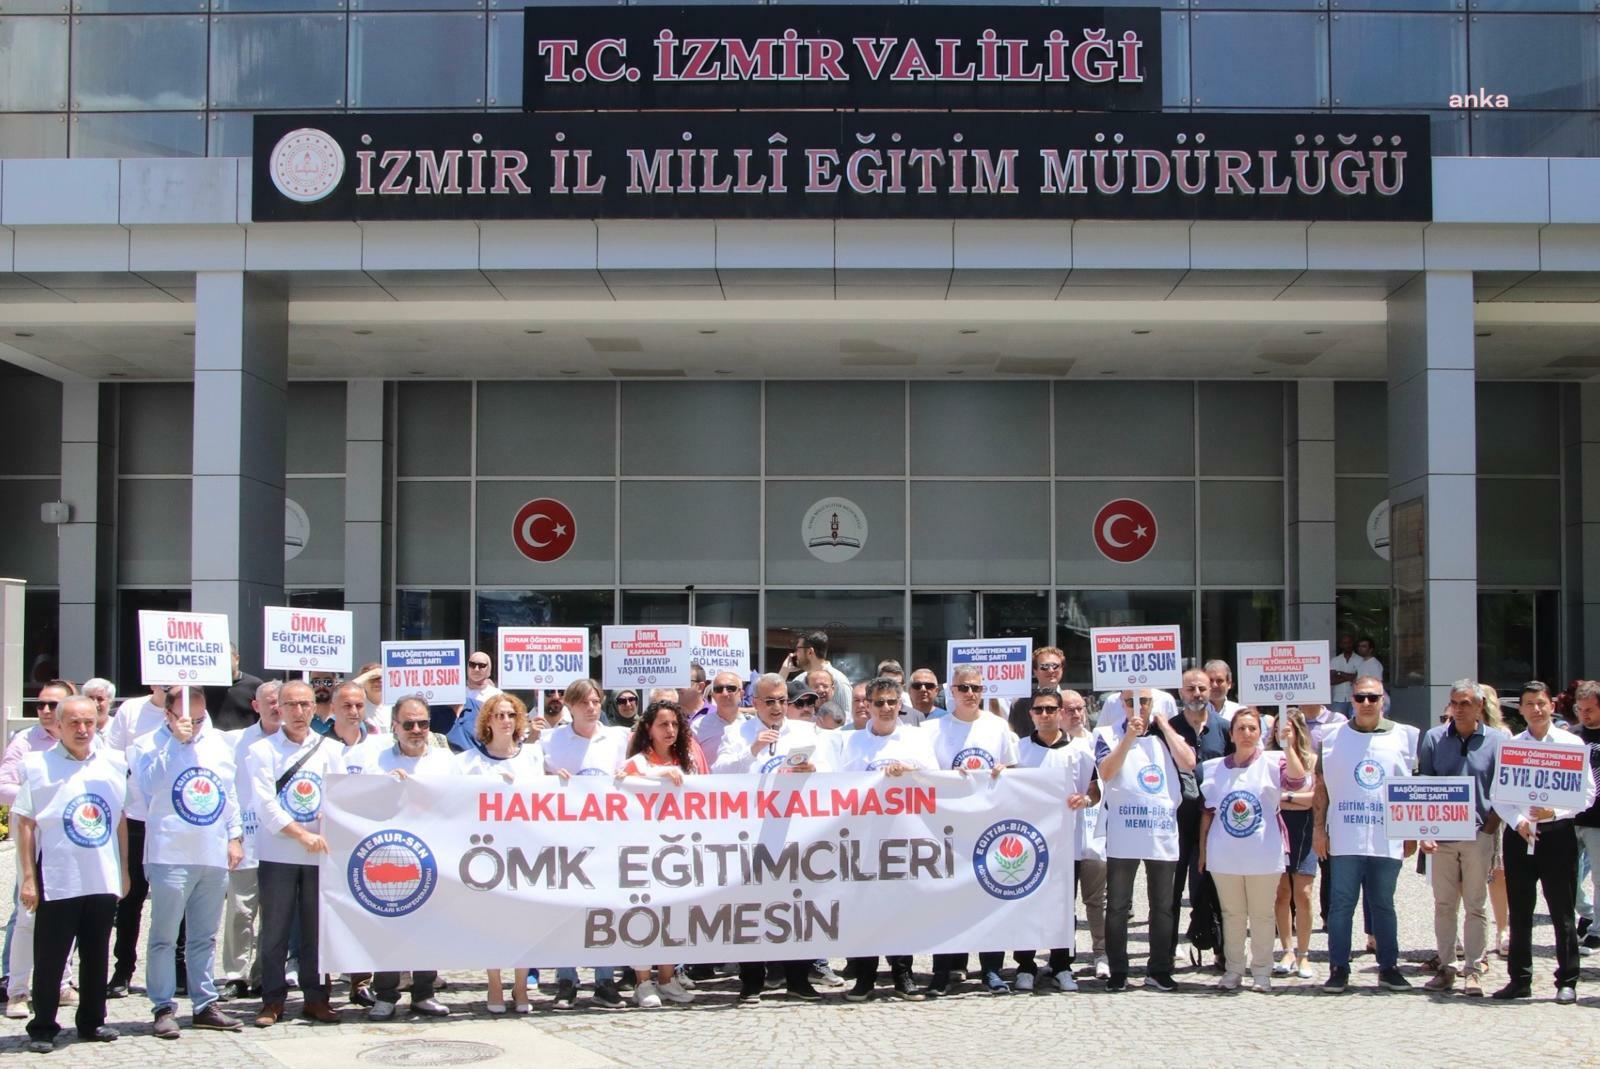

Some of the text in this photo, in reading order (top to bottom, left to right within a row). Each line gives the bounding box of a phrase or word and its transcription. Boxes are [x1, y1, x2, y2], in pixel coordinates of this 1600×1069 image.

[539, 28, 1144, 83] T.C. İZMİR VALİLİĞİ
[355, 133, 532, 195] İZMİR
[549, 131, 606, 194] İL
[626, 131, 788, 194] MİLLÎ
[803, 131, 1019, 194] EĞİTİM
[1039, 132, 1408, 195] MÜDÜRLÜĞÜ
[167, 617, 204, 640] ÖMK
[291, 612, 327, 633] ÖMK
[148, 639, 224, 654] EĞİTİMCİLERİ
[272, 630, 346, 645] EĞİTİMCİLERİ
[701, 630, 729, 648] ÖMK
[280, 642, 338, 656] BÖLMESİN
[157, 652, 217, 667] BÖLMESİN
[406, 657, 423, 665] SÜRE
[504, 653, 584, 672] 5 YIL OLSUN
[623, 656, 671, 666] MALİ KAYIP
[1097, 652, 1176, 673] 5 YIL OLSUN
[388, 669, 460, 688] 10 YIL OLSUN
[617, 665, 677, 676] YAŞATMAMALI
[987, 664, 1025, 681] OLSUN
[1259, 673, 1308, 682] MALİ KAYIP
[1253, 682, 1316, 693] YAŞATMAMALI
[1503, 748, 1527, 757] UZMAN
[1499, 766, 1582, 793] 5 YIL OLSUN
[479, 787, 936, 822] HAKLAR YARIM KALMASIN
[1408, 792, 1428, 800] SÜRE
[1389, 804, 1469, 822] 10 YIL OLSUN
[357, 832, 429, 859] MEMUR-SEN
[458, 825, 955, 892] ÖMK EĞİTİMCİLERİ
[584, 888, 839, 948] BÖLMESİN
